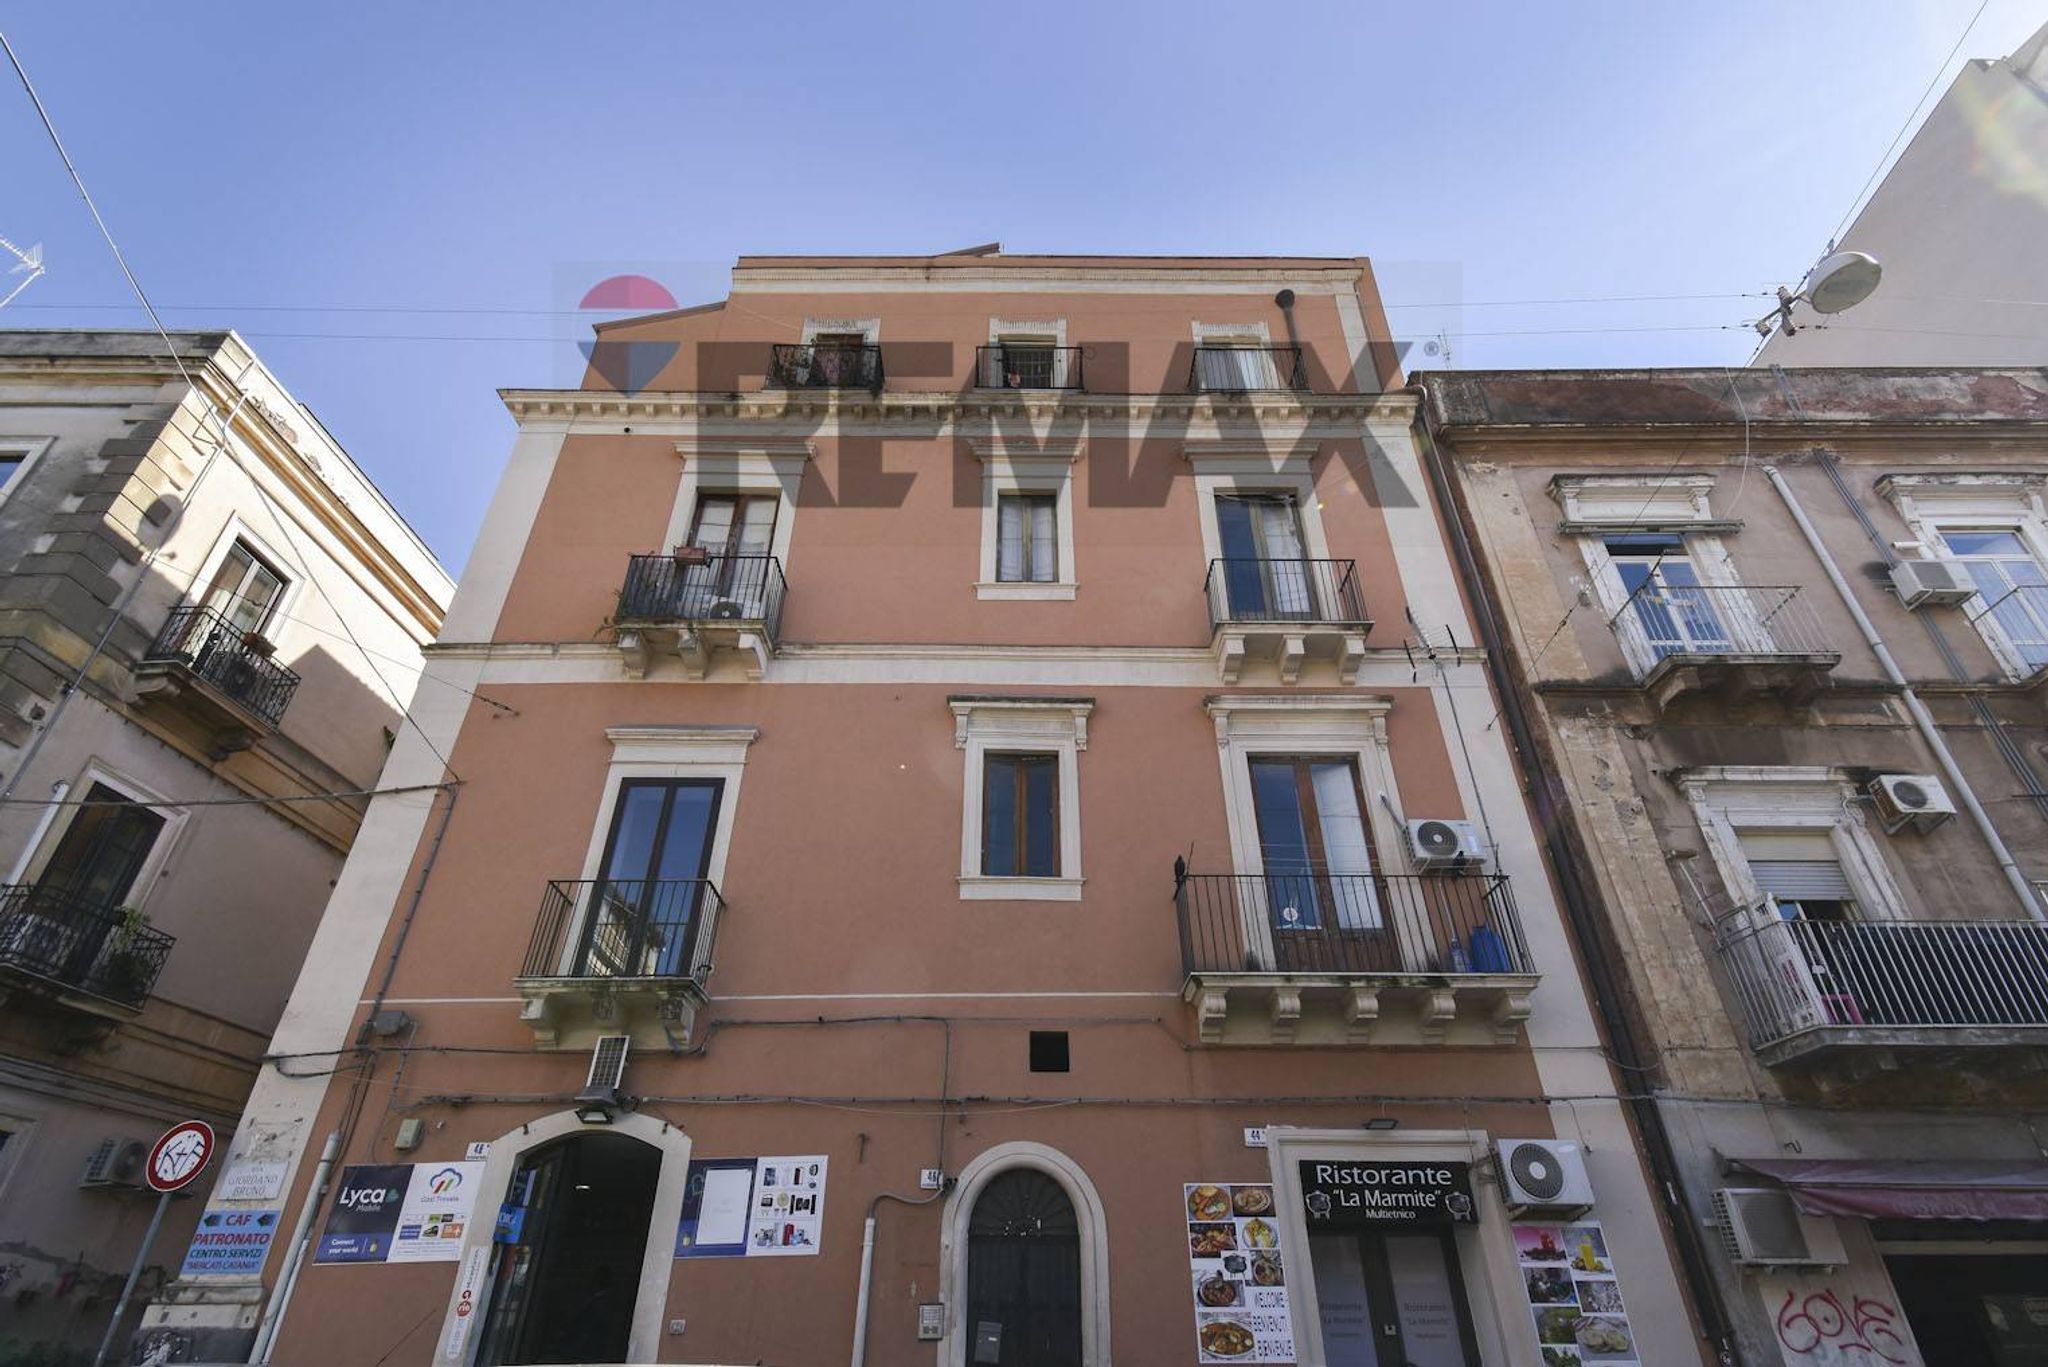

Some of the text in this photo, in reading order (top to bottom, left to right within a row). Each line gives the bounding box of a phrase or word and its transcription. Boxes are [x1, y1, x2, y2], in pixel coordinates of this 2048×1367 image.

[1316, 1165, 1452, 1185] Ristorante
[340, 1187, 386, 1208] Lyca
[226, 1214, 252, 1226] CAF
[193, 1233, 270, 1245] PATRONATO
[190, 1249, 227, 1259] CENTRO
